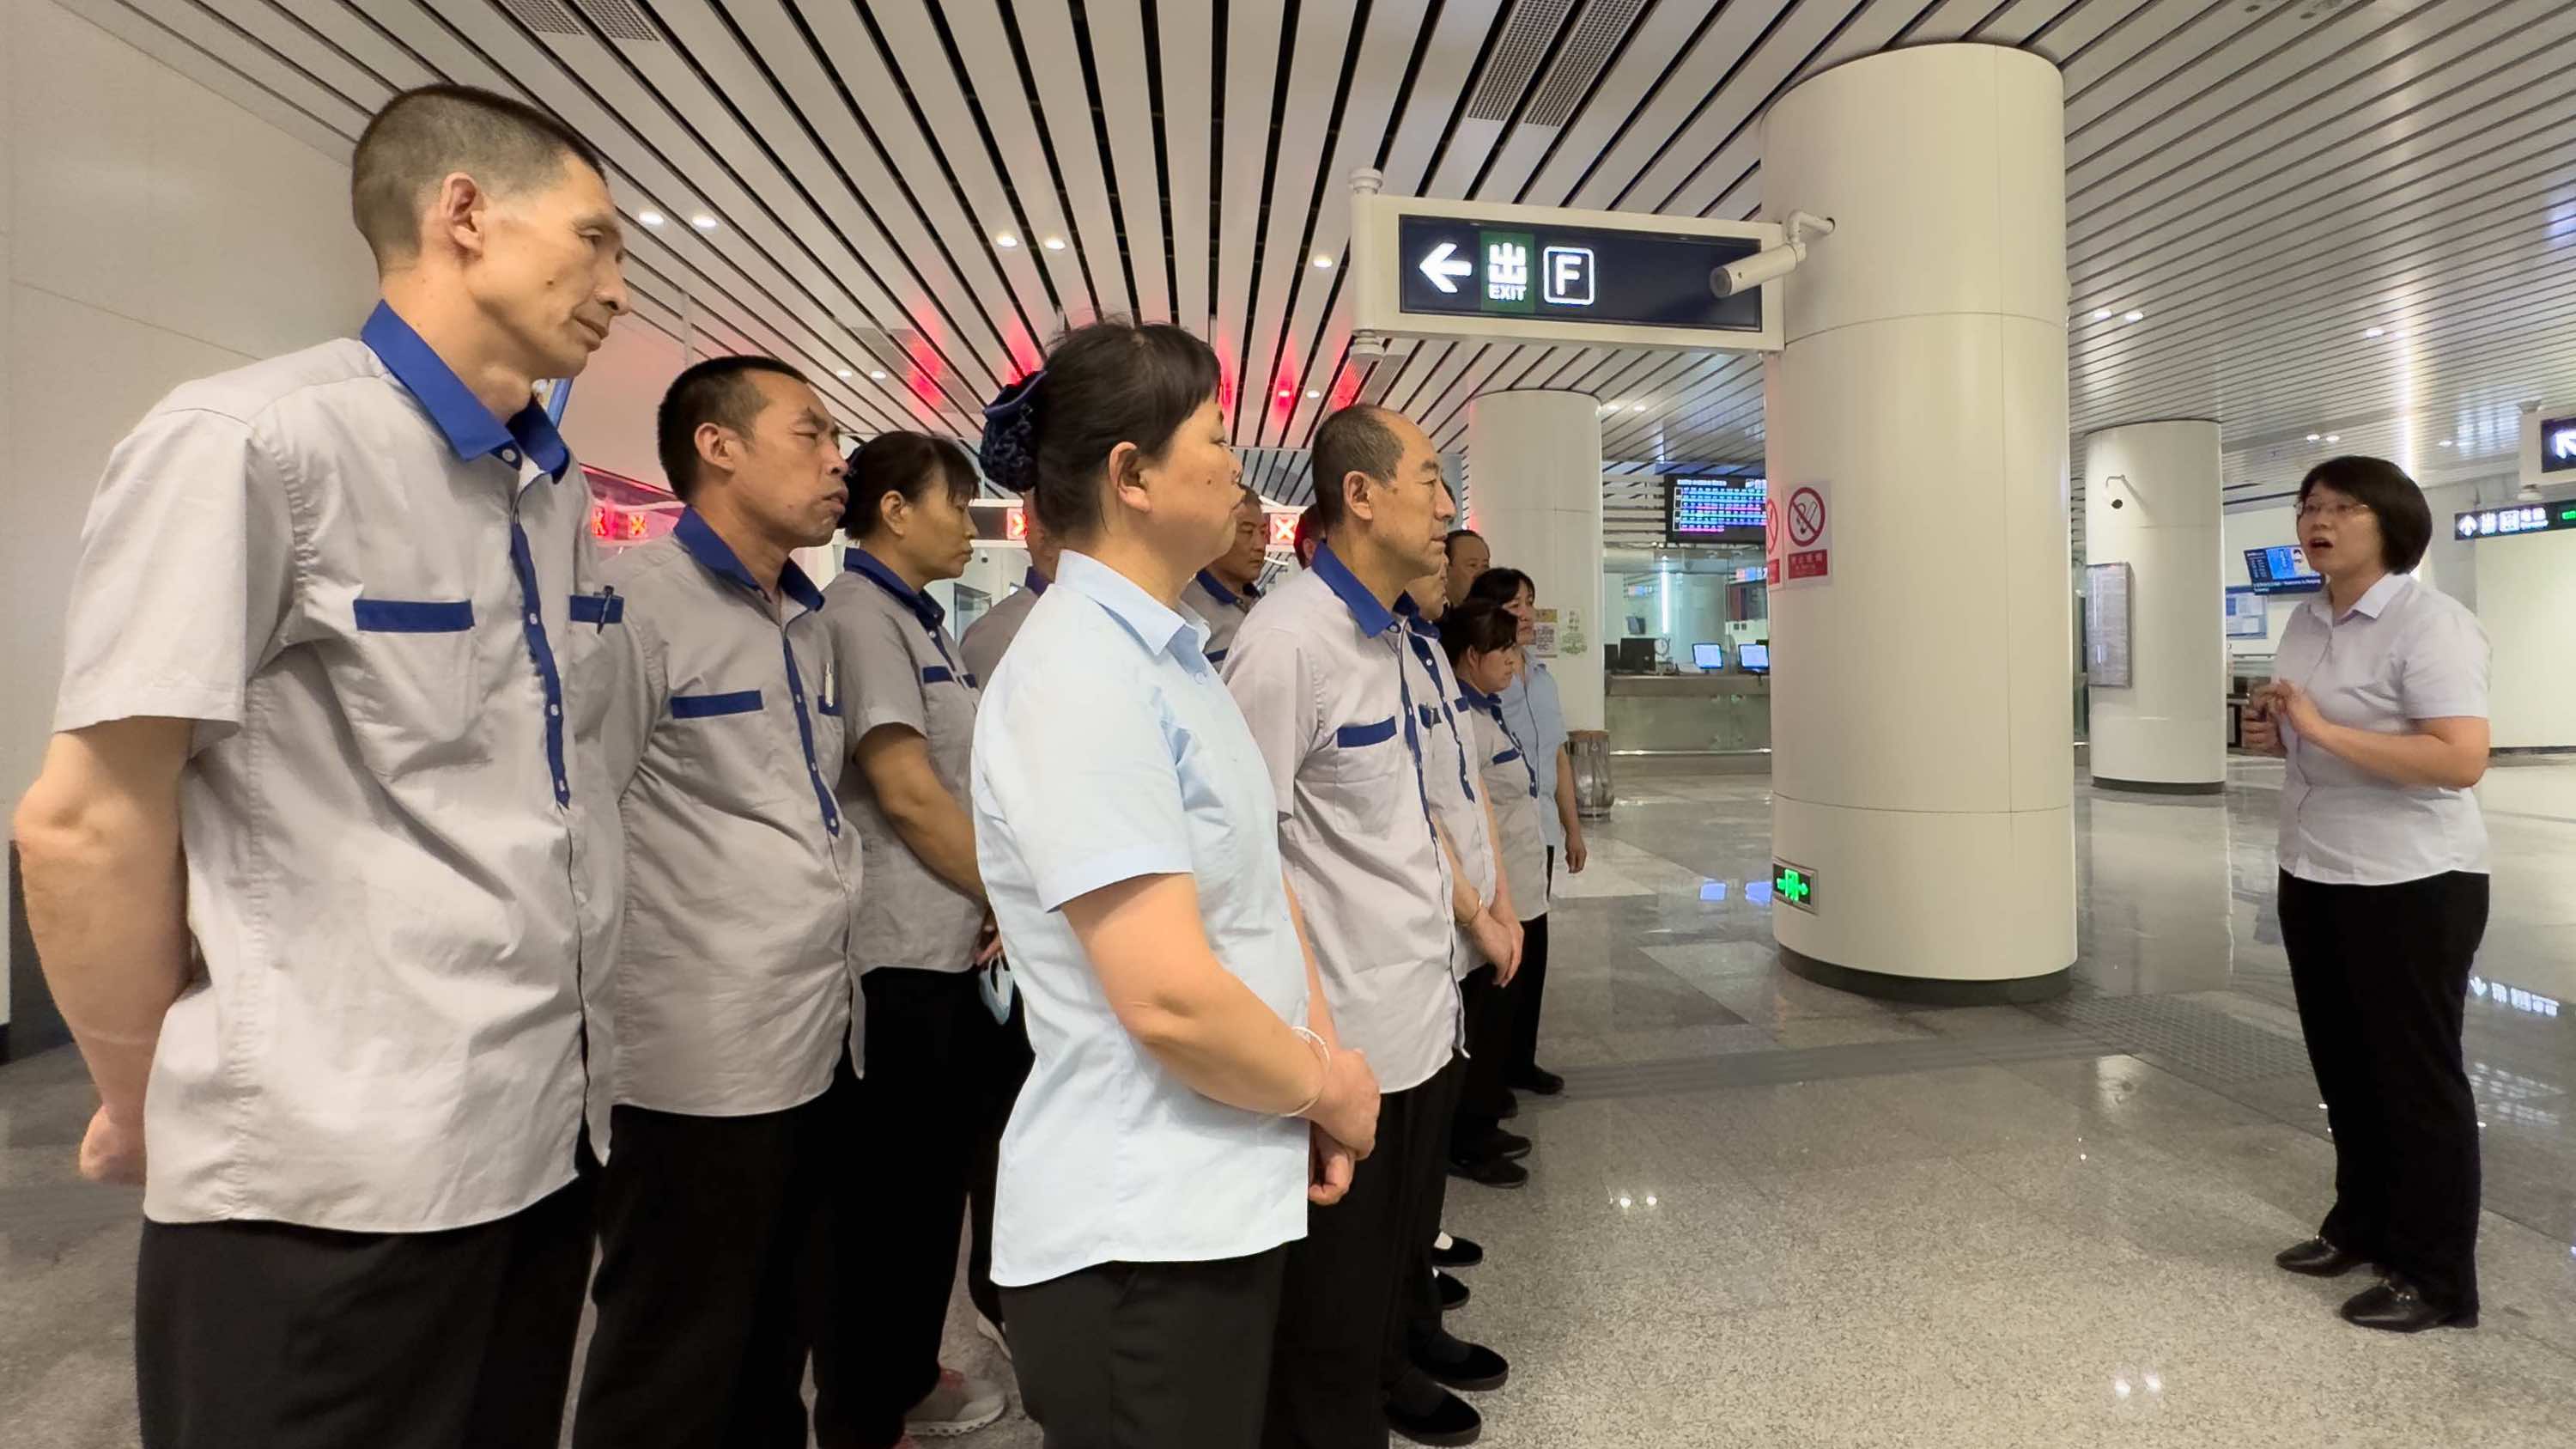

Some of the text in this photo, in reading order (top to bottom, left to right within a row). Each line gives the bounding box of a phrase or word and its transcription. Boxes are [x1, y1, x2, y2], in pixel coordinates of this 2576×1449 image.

[1488, 242, 1527, 284] 出
[1556, 254, 1582, 295] F
[1488, 283, 1527, 301] EXIT
